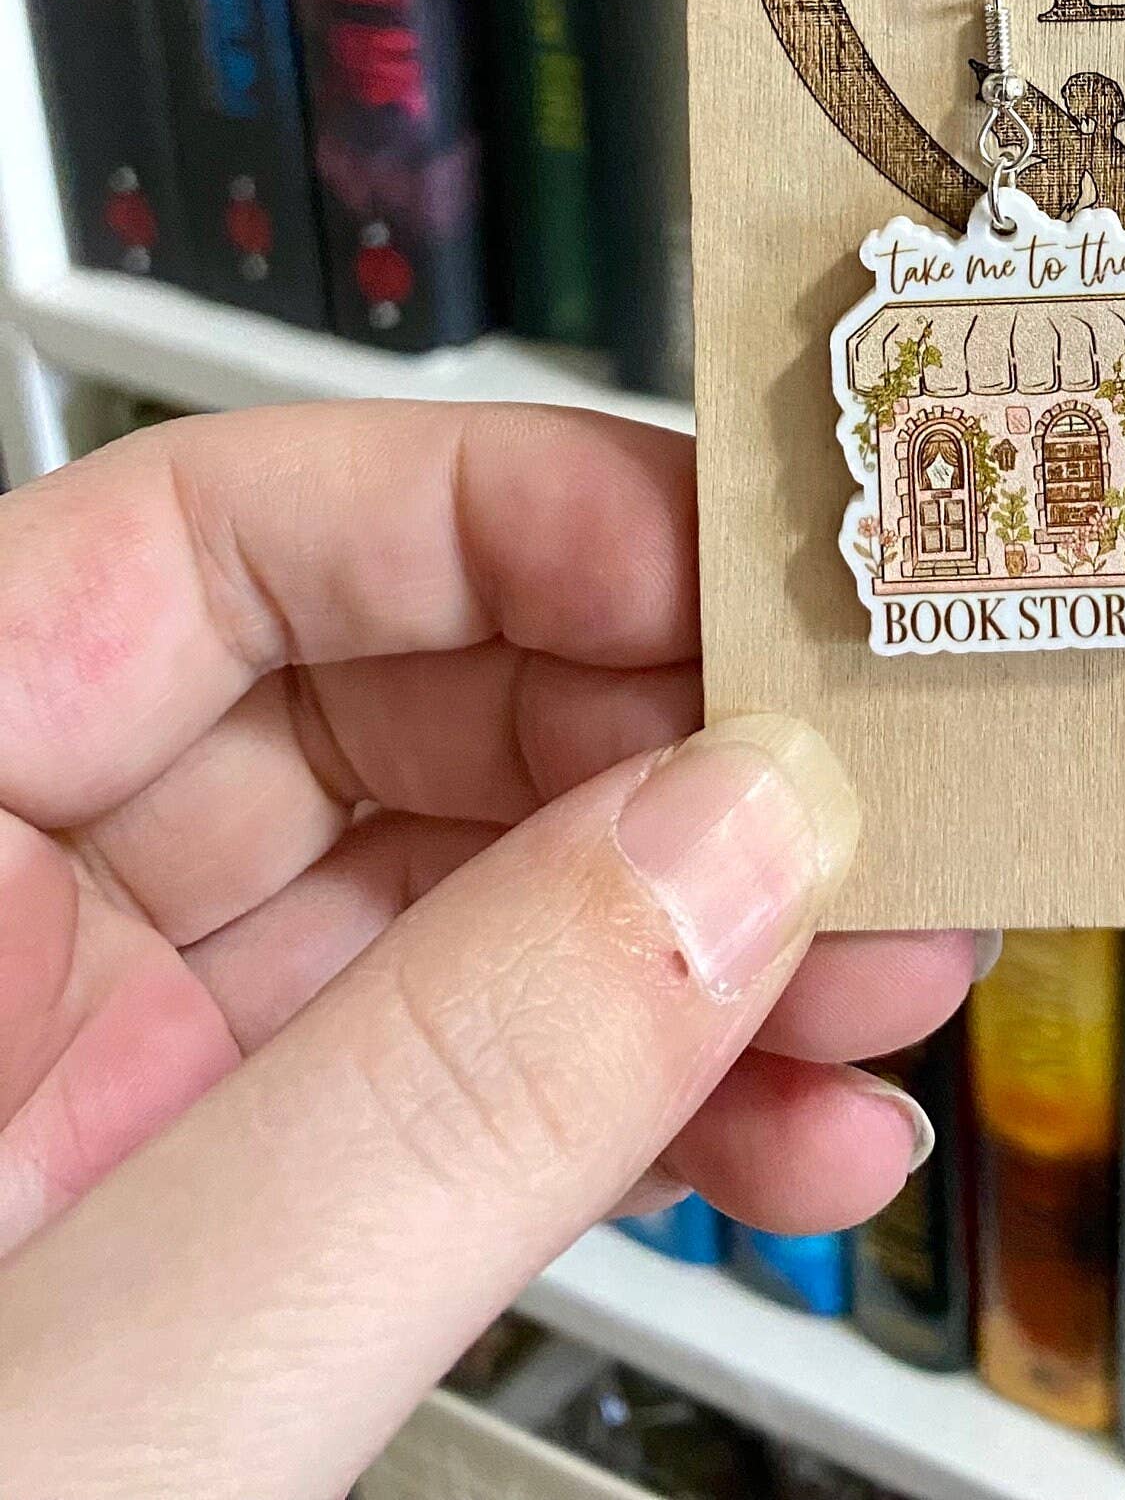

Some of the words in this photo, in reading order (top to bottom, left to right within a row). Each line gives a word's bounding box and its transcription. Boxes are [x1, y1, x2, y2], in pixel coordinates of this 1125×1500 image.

[875, 240, 955, 295] take
[966, 254, 1017, 285] me
[1013, 235, 1068, 289] to
[883, 598, 1008, 645] BOOK
